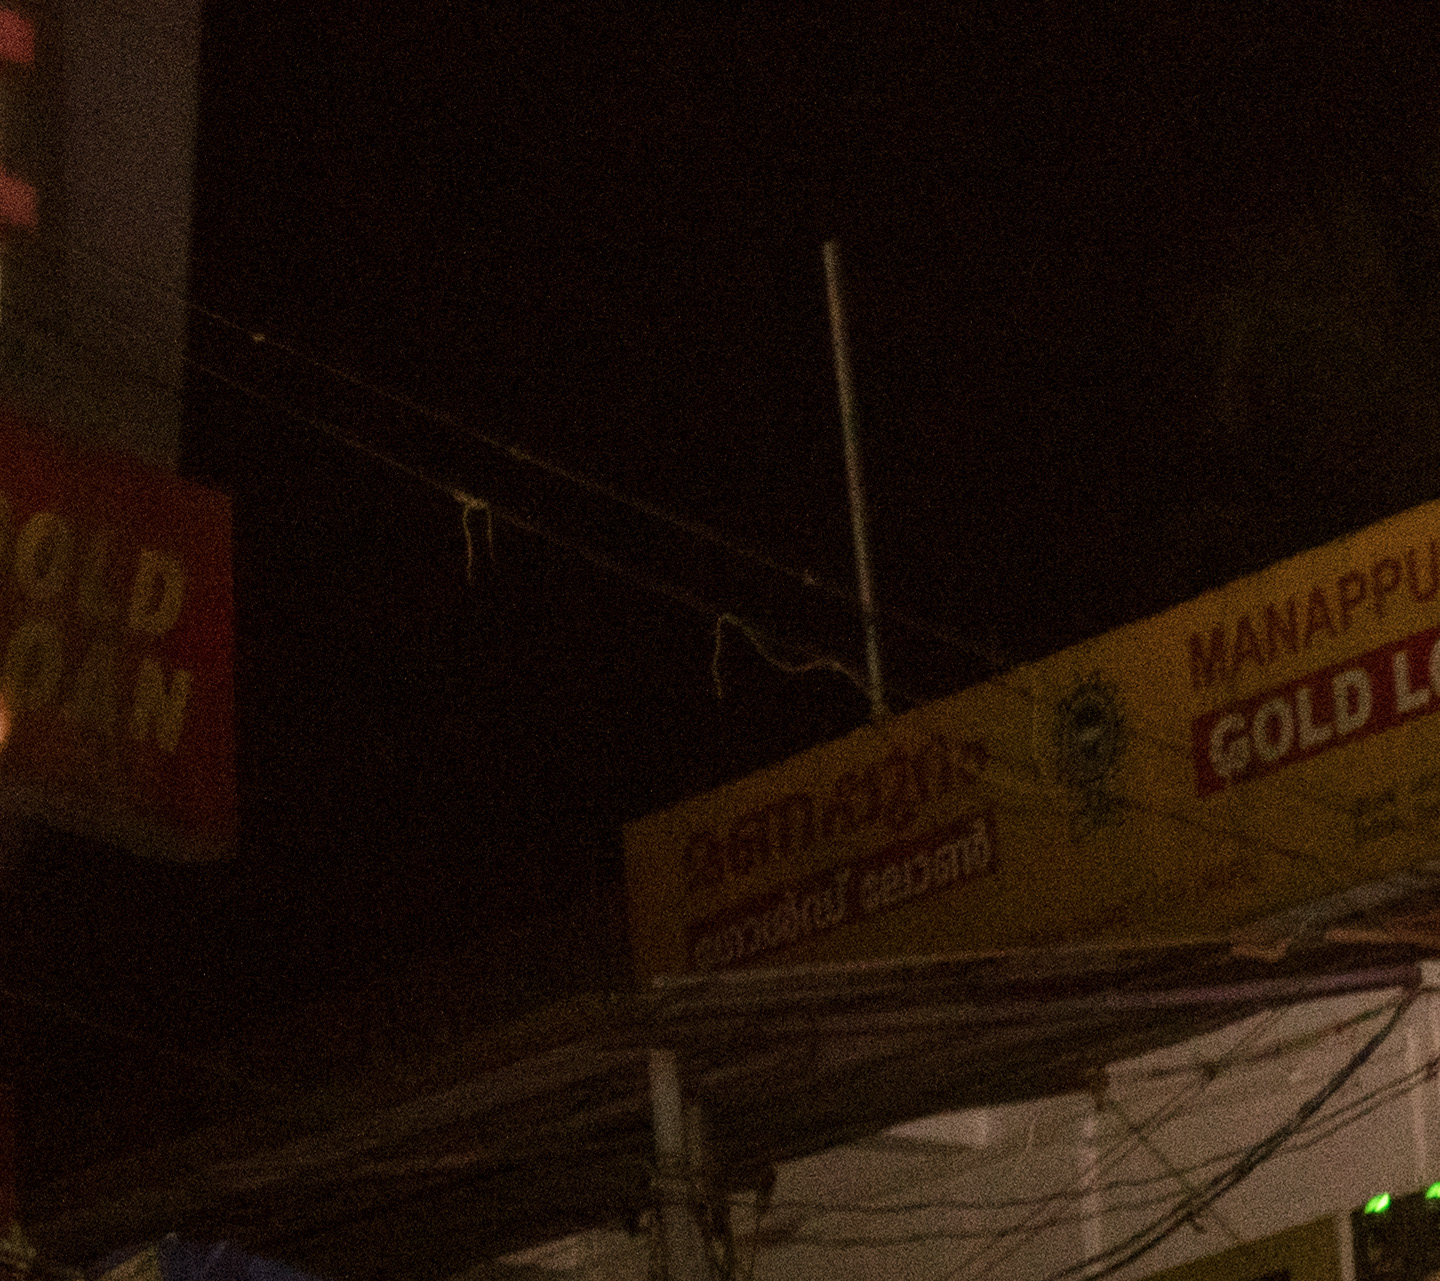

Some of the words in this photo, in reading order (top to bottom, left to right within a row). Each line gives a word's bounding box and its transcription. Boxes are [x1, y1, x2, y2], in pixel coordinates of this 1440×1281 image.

[0, 492, 187, 640] OLD
[0, 617, 192, 756] OAN
[1207, 664, 1373, 782] GOLD
